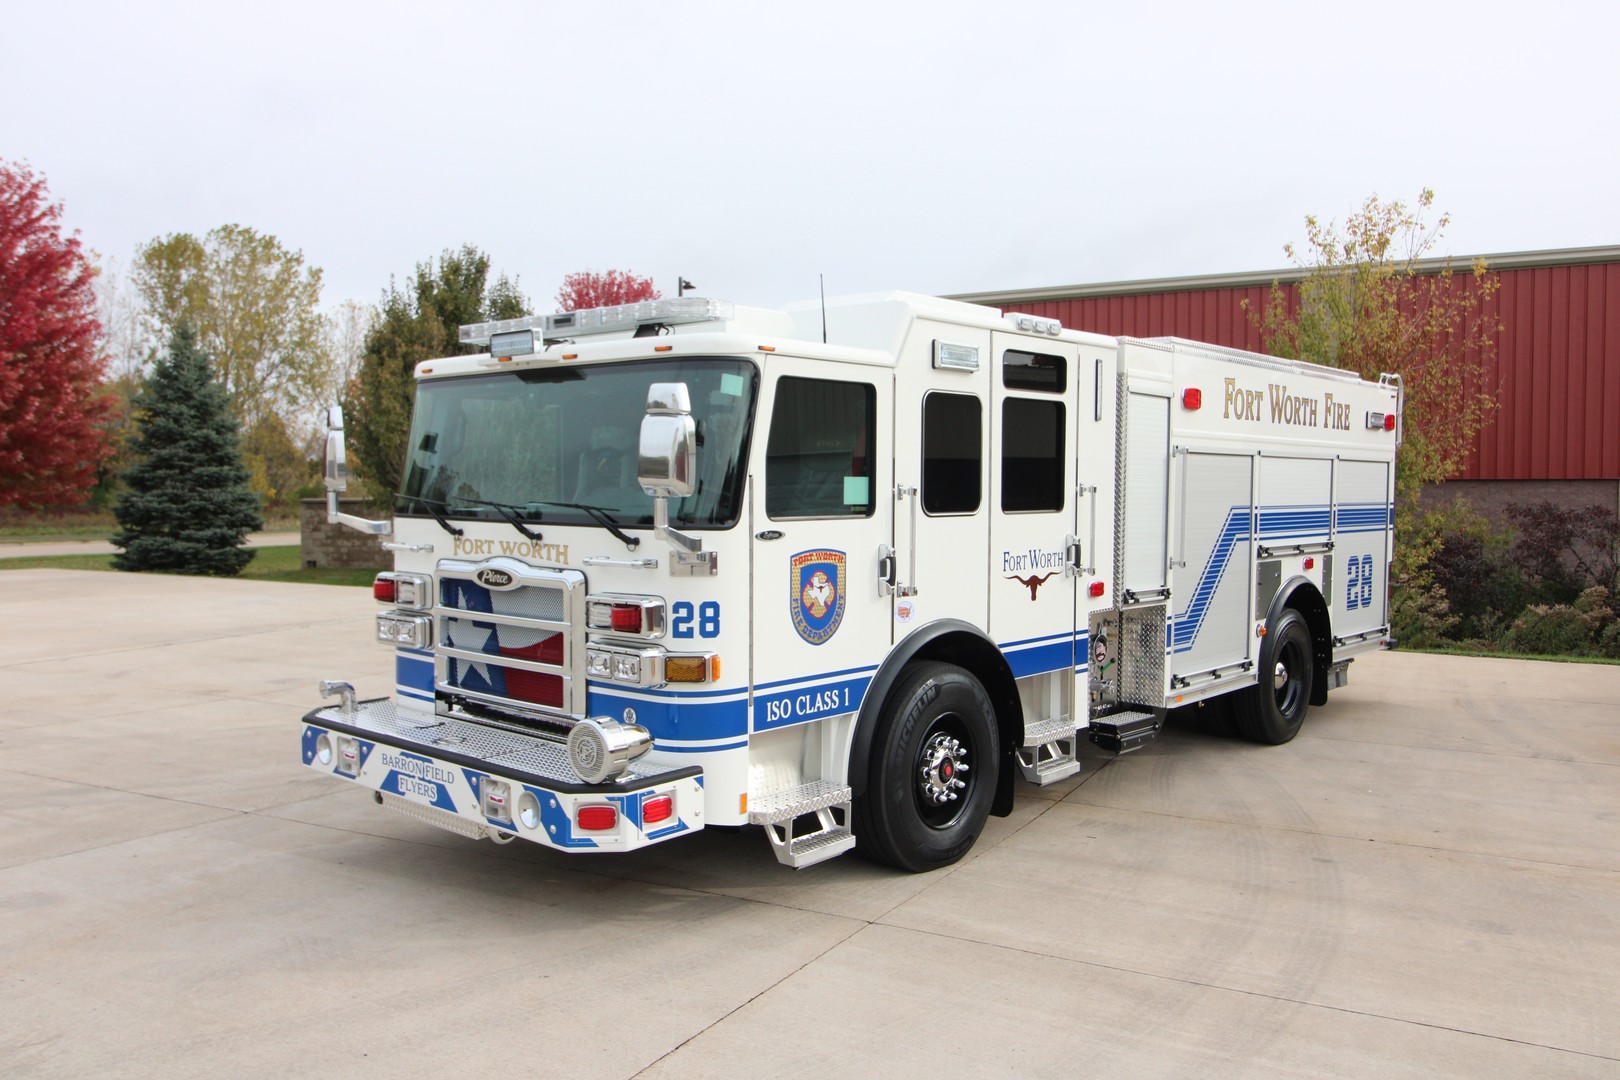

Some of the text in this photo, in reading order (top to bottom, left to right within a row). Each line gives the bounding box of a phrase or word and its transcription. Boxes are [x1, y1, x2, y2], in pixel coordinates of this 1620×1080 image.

[1223, 377, 1350, 431] FORT WORTH FIRE
[453, 537, 569, 565] FORT WORTH
[793, 551, 845, 566] FORT WORTH
[481, 569, 509, 584] Pierce
[1346, 554, 1373, 611] 28
[672, 600, 720, 639] 28
[792, 594, 844, 640] FIRE DEPARTMENT
[766, 687, 850, 722] ISO CLASS 1
[895, 686, 937, 761] MICHELIN
[381, 753, 455, 784] BARRON FIELD
[399, 777, 436, 799] FLYERS
